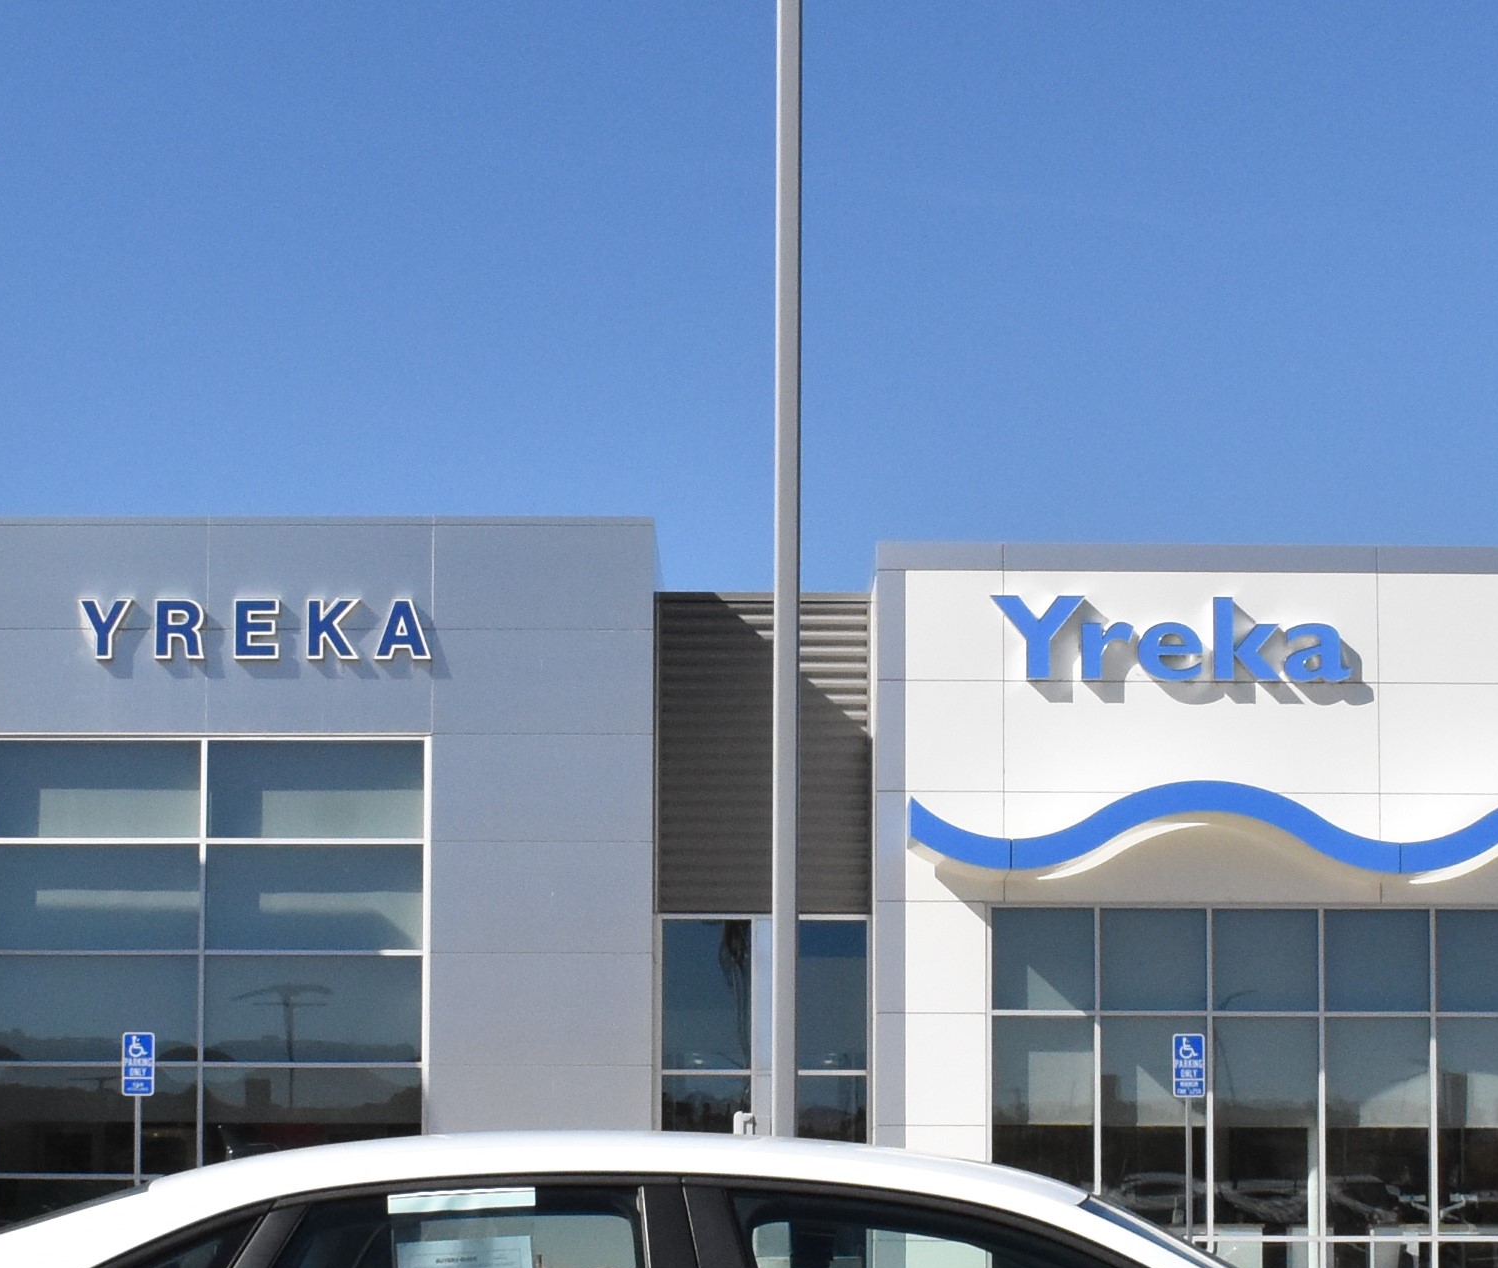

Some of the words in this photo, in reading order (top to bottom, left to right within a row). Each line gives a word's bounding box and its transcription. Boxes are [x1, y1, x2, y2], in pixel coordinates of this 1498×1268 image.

[78, 598, 432, 660] YREKA
[989, 594, 1353, 683] Yreka
[123, 1058, 154, 1067] PARKING
[1174, 1060, 1204, 1069] PARKING
[129, 1067, 147, 1077] ONLY
[1180, 1069, 1198, 1079] ONLY
